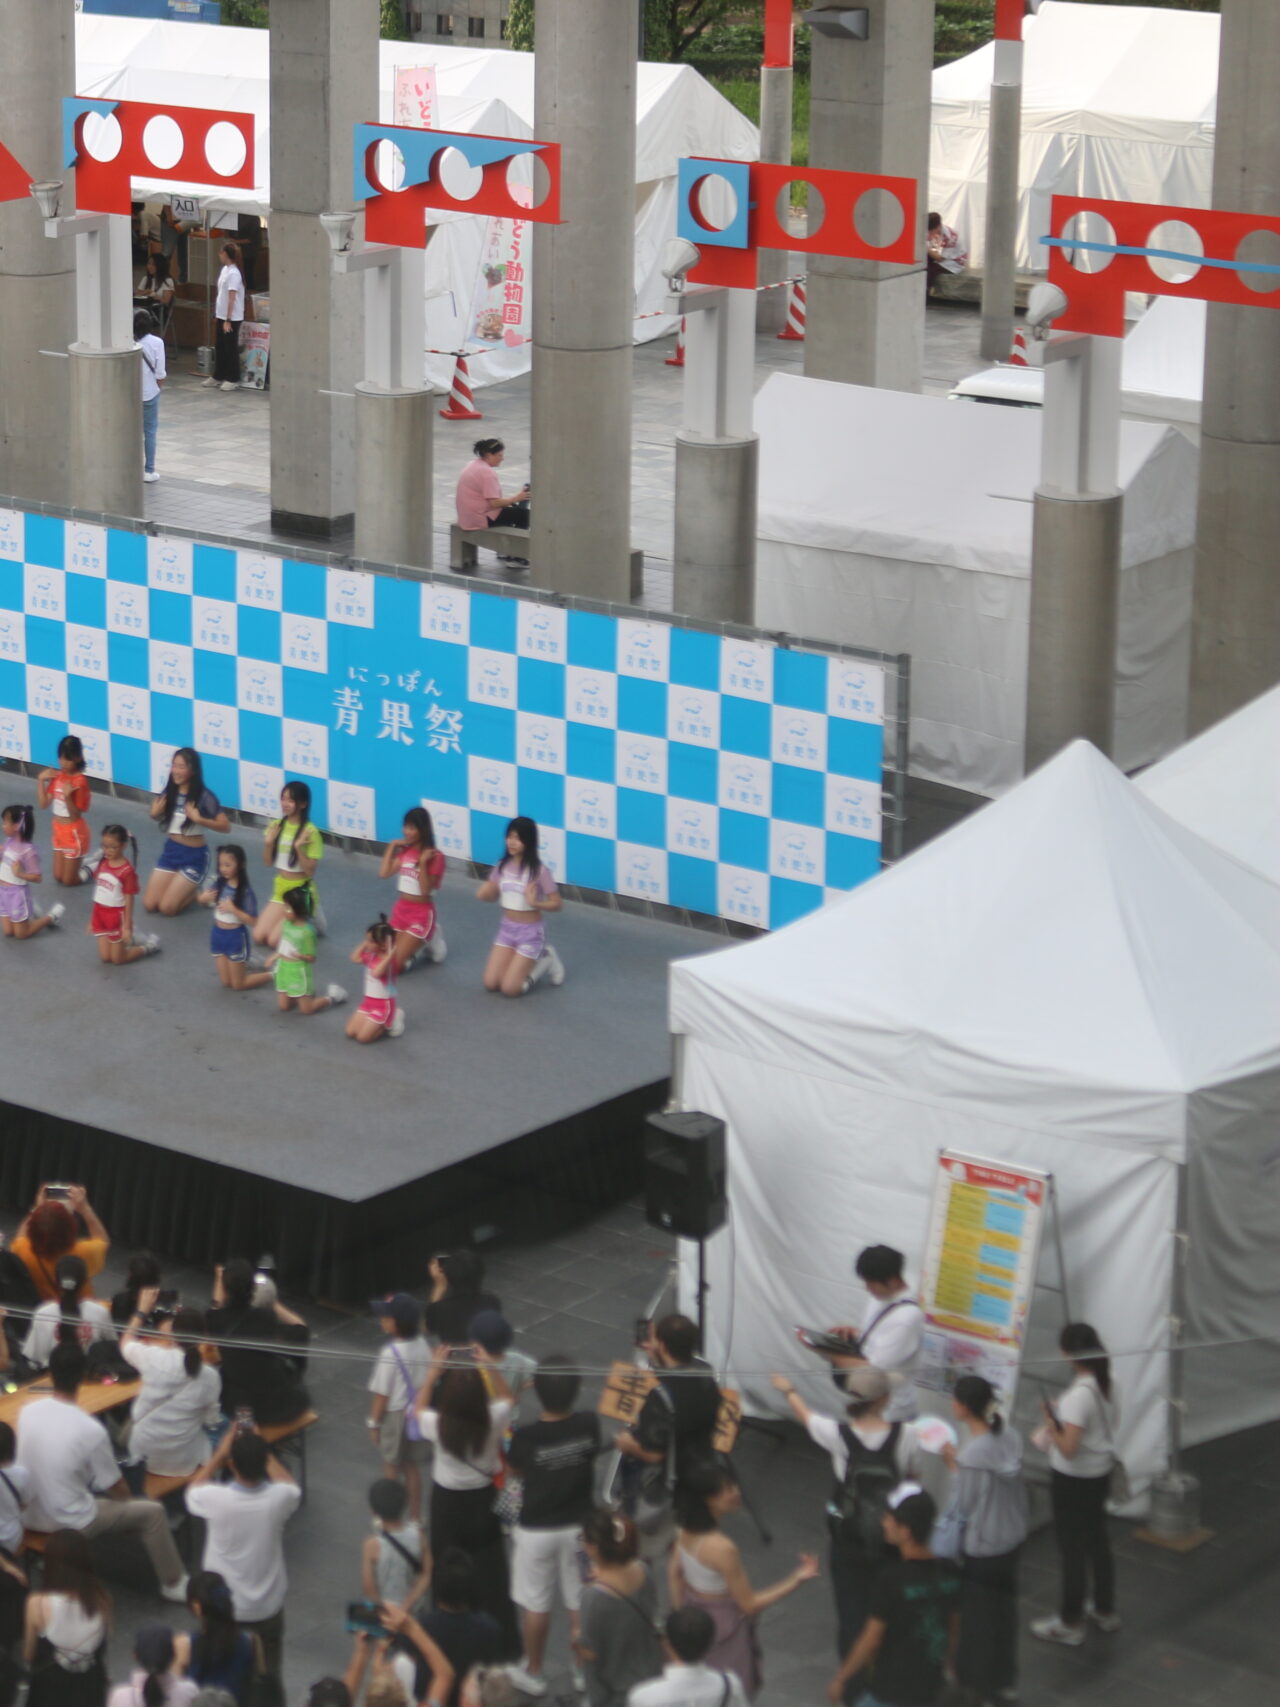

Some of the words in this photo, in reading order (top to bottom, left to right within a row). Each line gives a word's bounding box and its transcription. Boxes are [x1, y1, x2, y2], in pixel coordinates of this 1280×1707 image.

[399, 82, 412, 126] ふれ
[414, 82, 432, 127] いど
[175, 199, 195, 212] 入口
[502, 203, 529, 325] どう動物園
[348, 666, 442, 697] にっぽん
[331, 686, 464, 754] 青果祭
